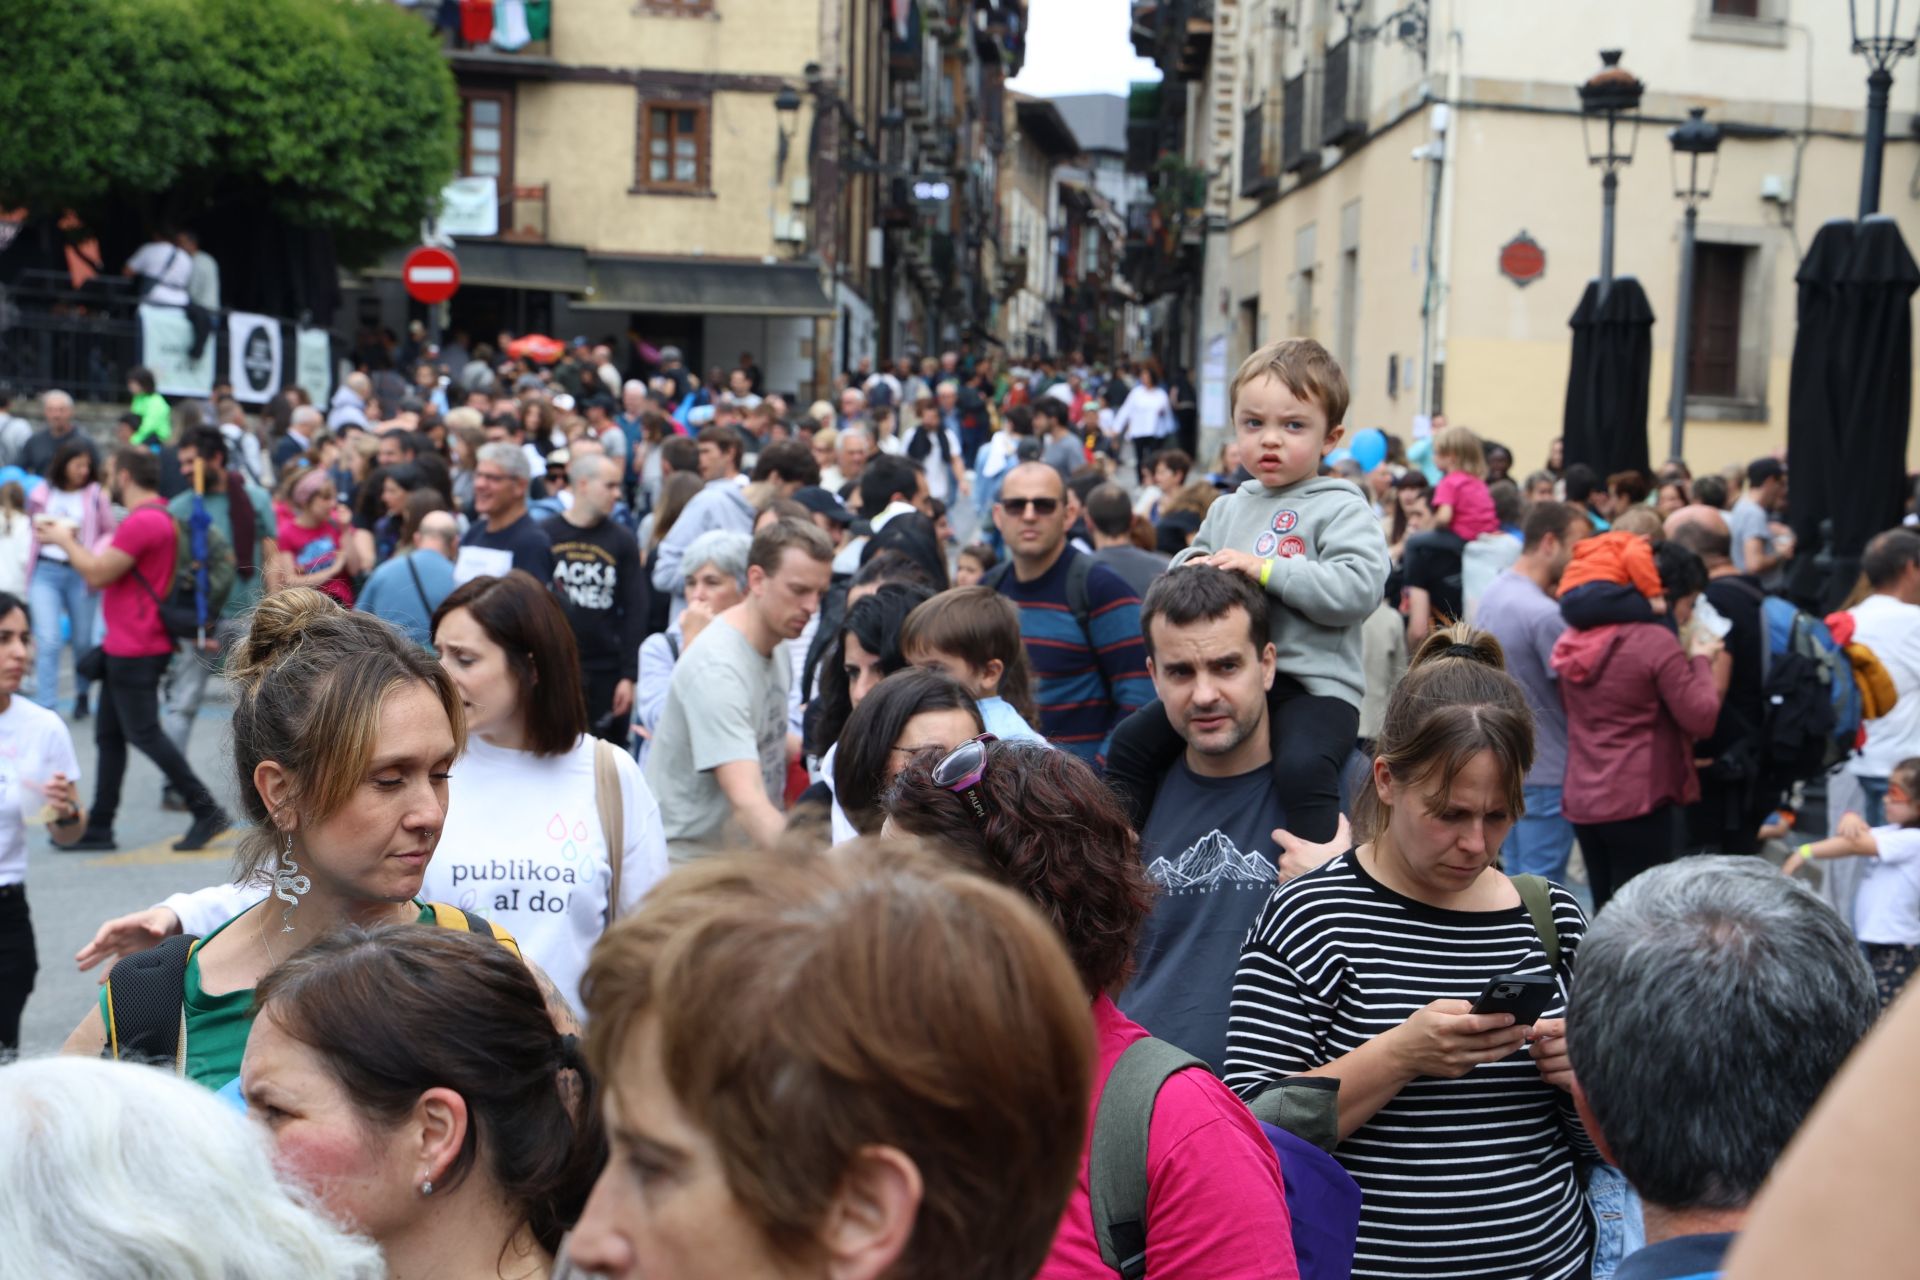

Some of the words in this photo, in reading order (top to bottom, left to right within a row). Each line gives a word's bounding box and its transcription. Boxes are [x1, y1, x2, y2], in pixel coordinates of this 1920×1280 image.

[551, 559, 617, 588] ACK&
[967, 789, 985, 817] RALPH
[451, 858, 576, 886] publikoa
[494, 888, 520, 911] aI
[529, 889, 572, 915] do!
